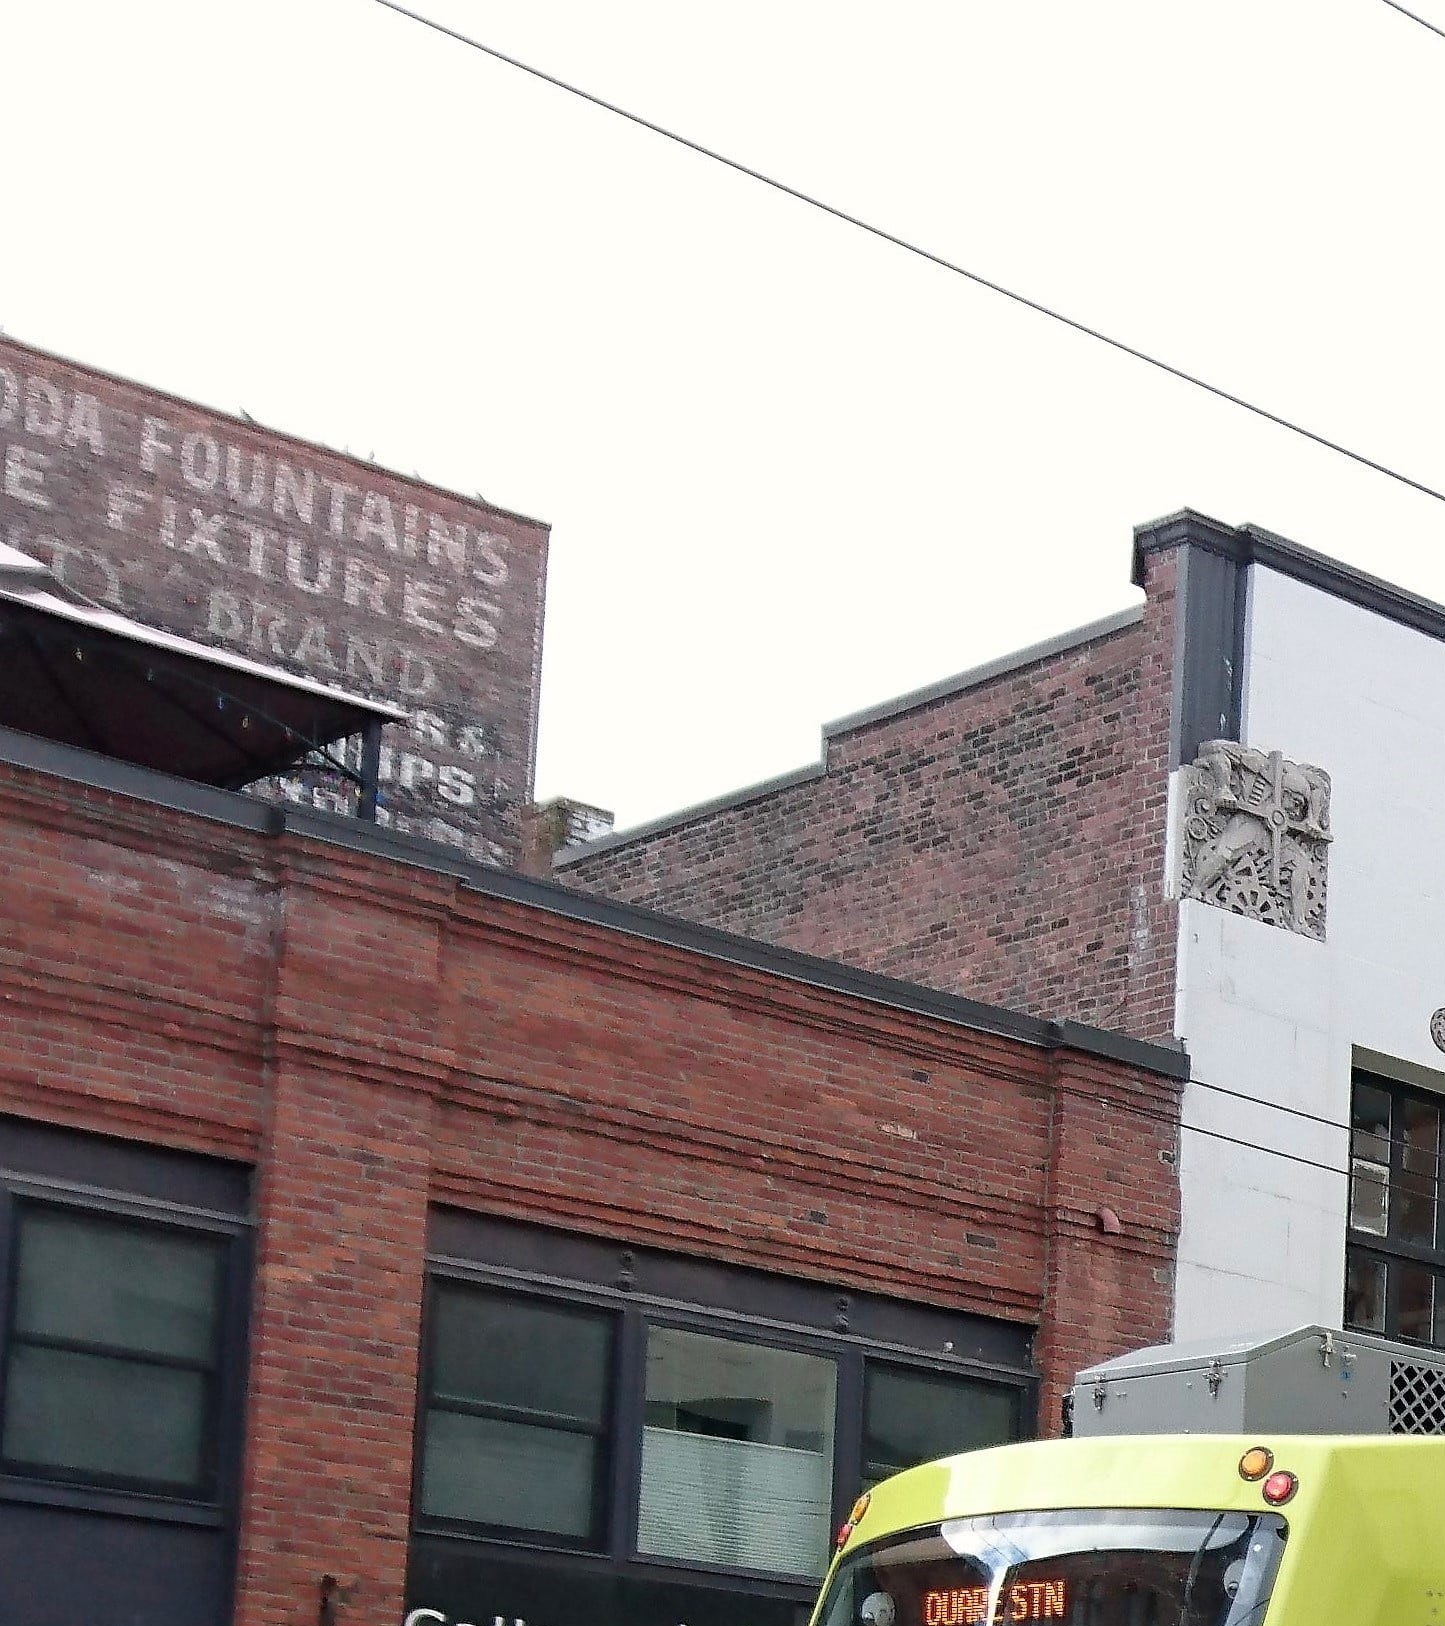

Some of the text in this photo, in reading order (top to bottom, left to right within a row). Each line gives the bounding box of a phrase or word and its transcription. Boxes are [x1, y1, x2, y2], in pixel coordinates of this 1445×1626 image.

[105, 480, 501, 649] FIXTURES
[139, 411, 509, 587] FOUNTAINS
[1010, 1577, 1065, 1620] STN
